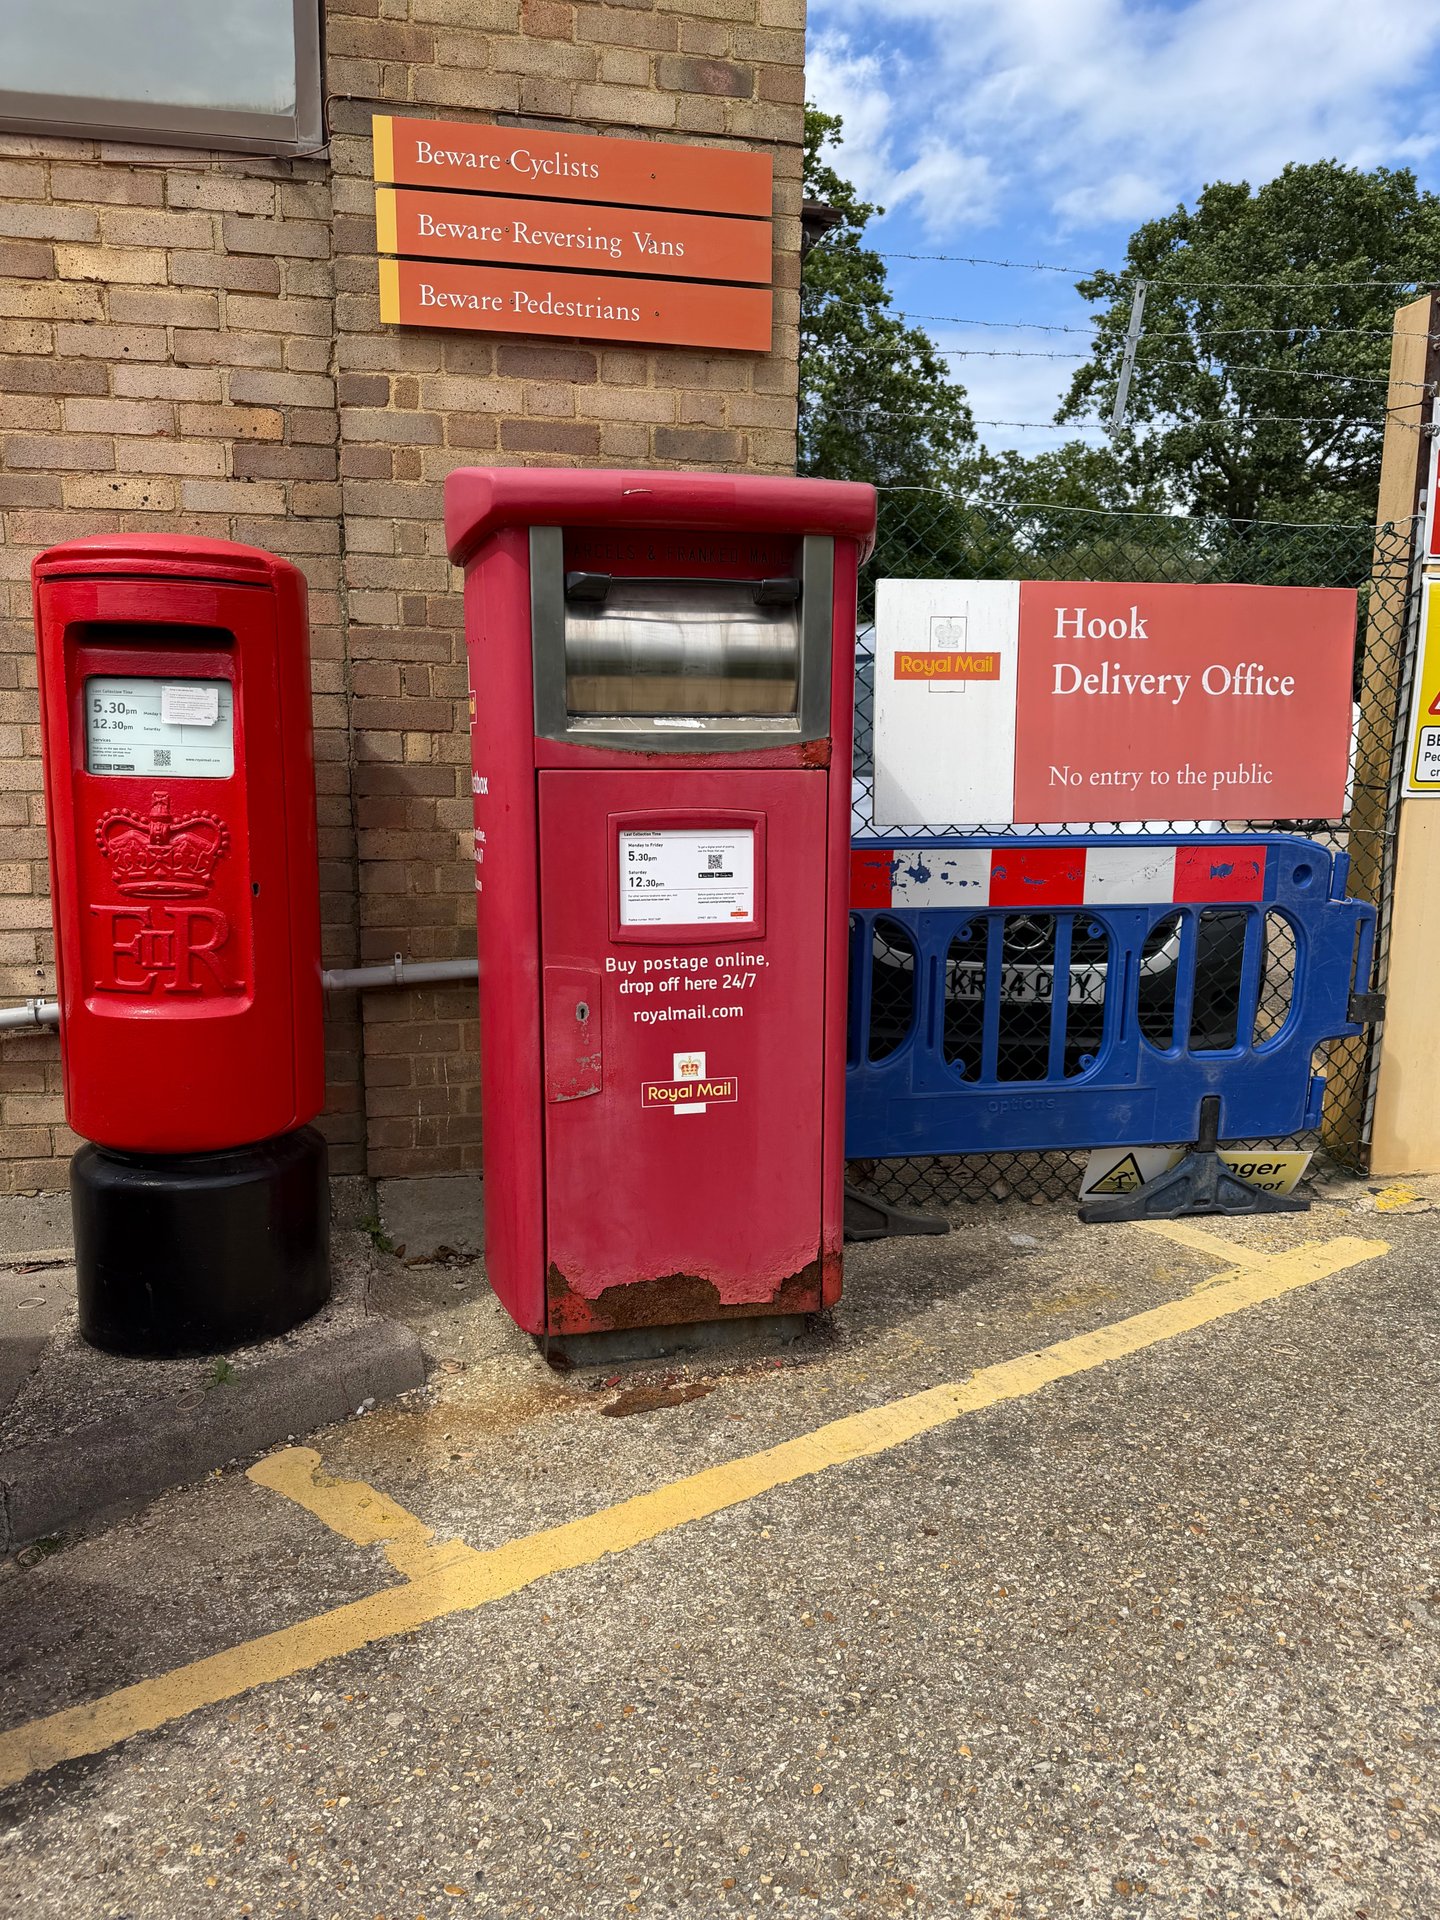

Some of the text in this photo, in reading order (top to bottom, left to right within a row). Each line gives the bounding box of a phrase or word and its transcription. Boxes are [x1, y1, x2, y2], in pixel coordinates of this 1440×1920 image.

[415, 140, 600, 180] Beware Cyclists
[417, 213, 685, 259] Beware Reversing Vans
[419, 283, 641, 322] Beware Pedestrians
[647, 545, 656, 560] &
[666, 545, 738, 564] FRANKED
[1052, 605, 1149, 640] Hook
[900, 655, 993, 676] Royal Mail
[1051, 661, 1295, 705] Delivery Office
[93, 698, 138, 715] 5.30pm
[92, 718, 134, 730] 12.30pm
[1048, 763, 1273, 792] No entry to the public
[628, 850, 658, 862] 5.30pm
[629, 876, 665, 888] 12.30pm
[605, 952, 770, 975] Buy postage online,
[619, 972, 757, 996] drop off here 24/7
[633, 1004, 744, 1025] royalmail.com
[648, 1082, 731, 1102] Royal Mail
